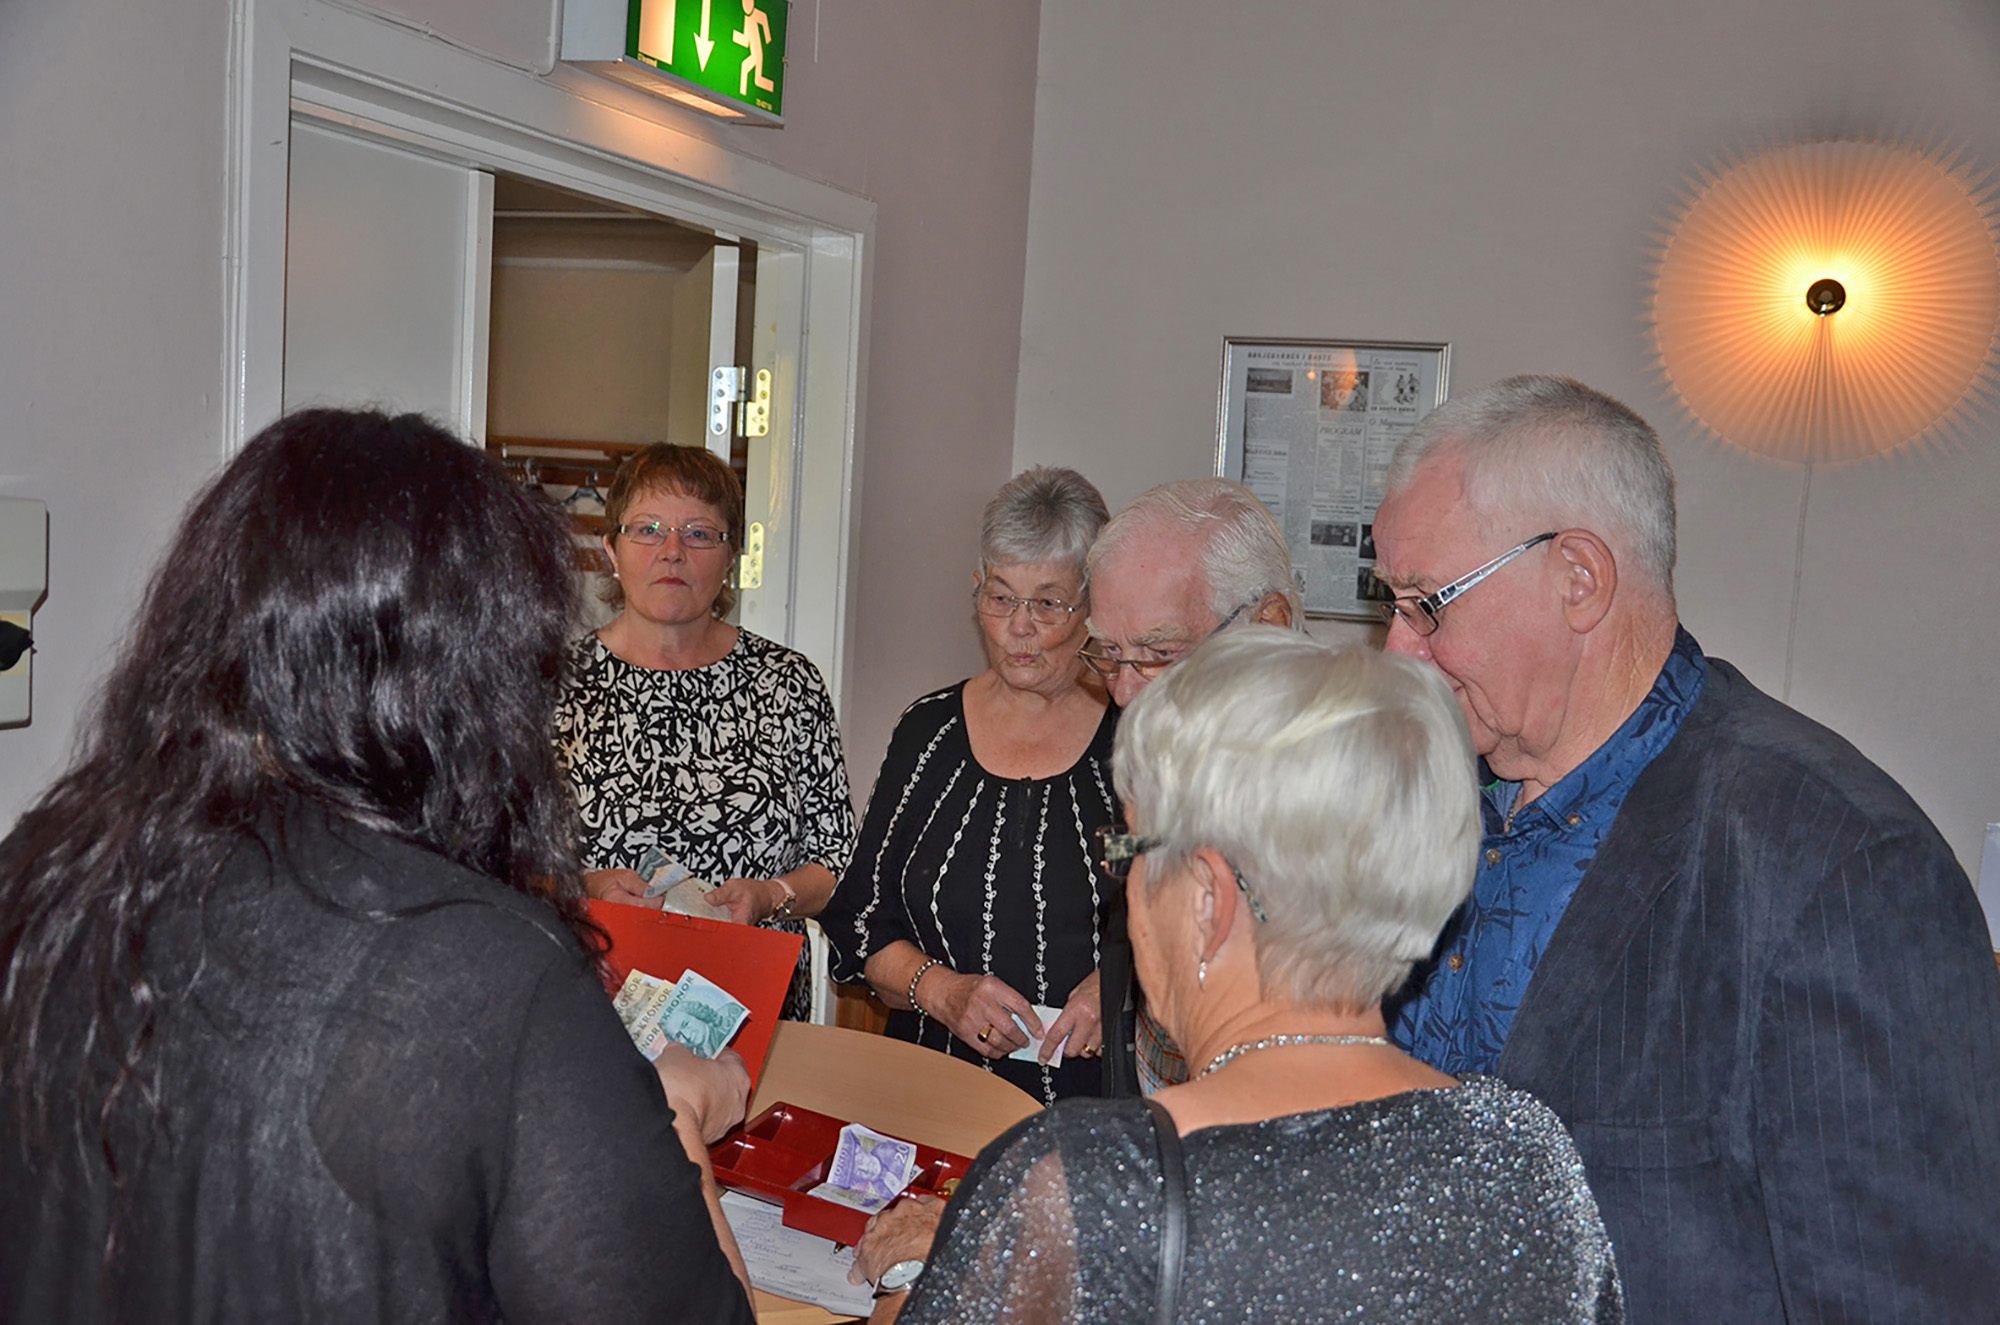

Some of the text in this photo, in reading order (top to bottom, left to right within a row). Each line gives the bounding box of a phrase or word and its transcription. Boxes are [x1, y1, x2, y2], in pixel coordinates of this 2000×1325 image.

[616, 977, 641, 1014] RONOR
[637, 987, 672, 1030] KRONOR
[662, 976, 694, 1020] KRONOR
[894, 1144, 909, 1163] 20
